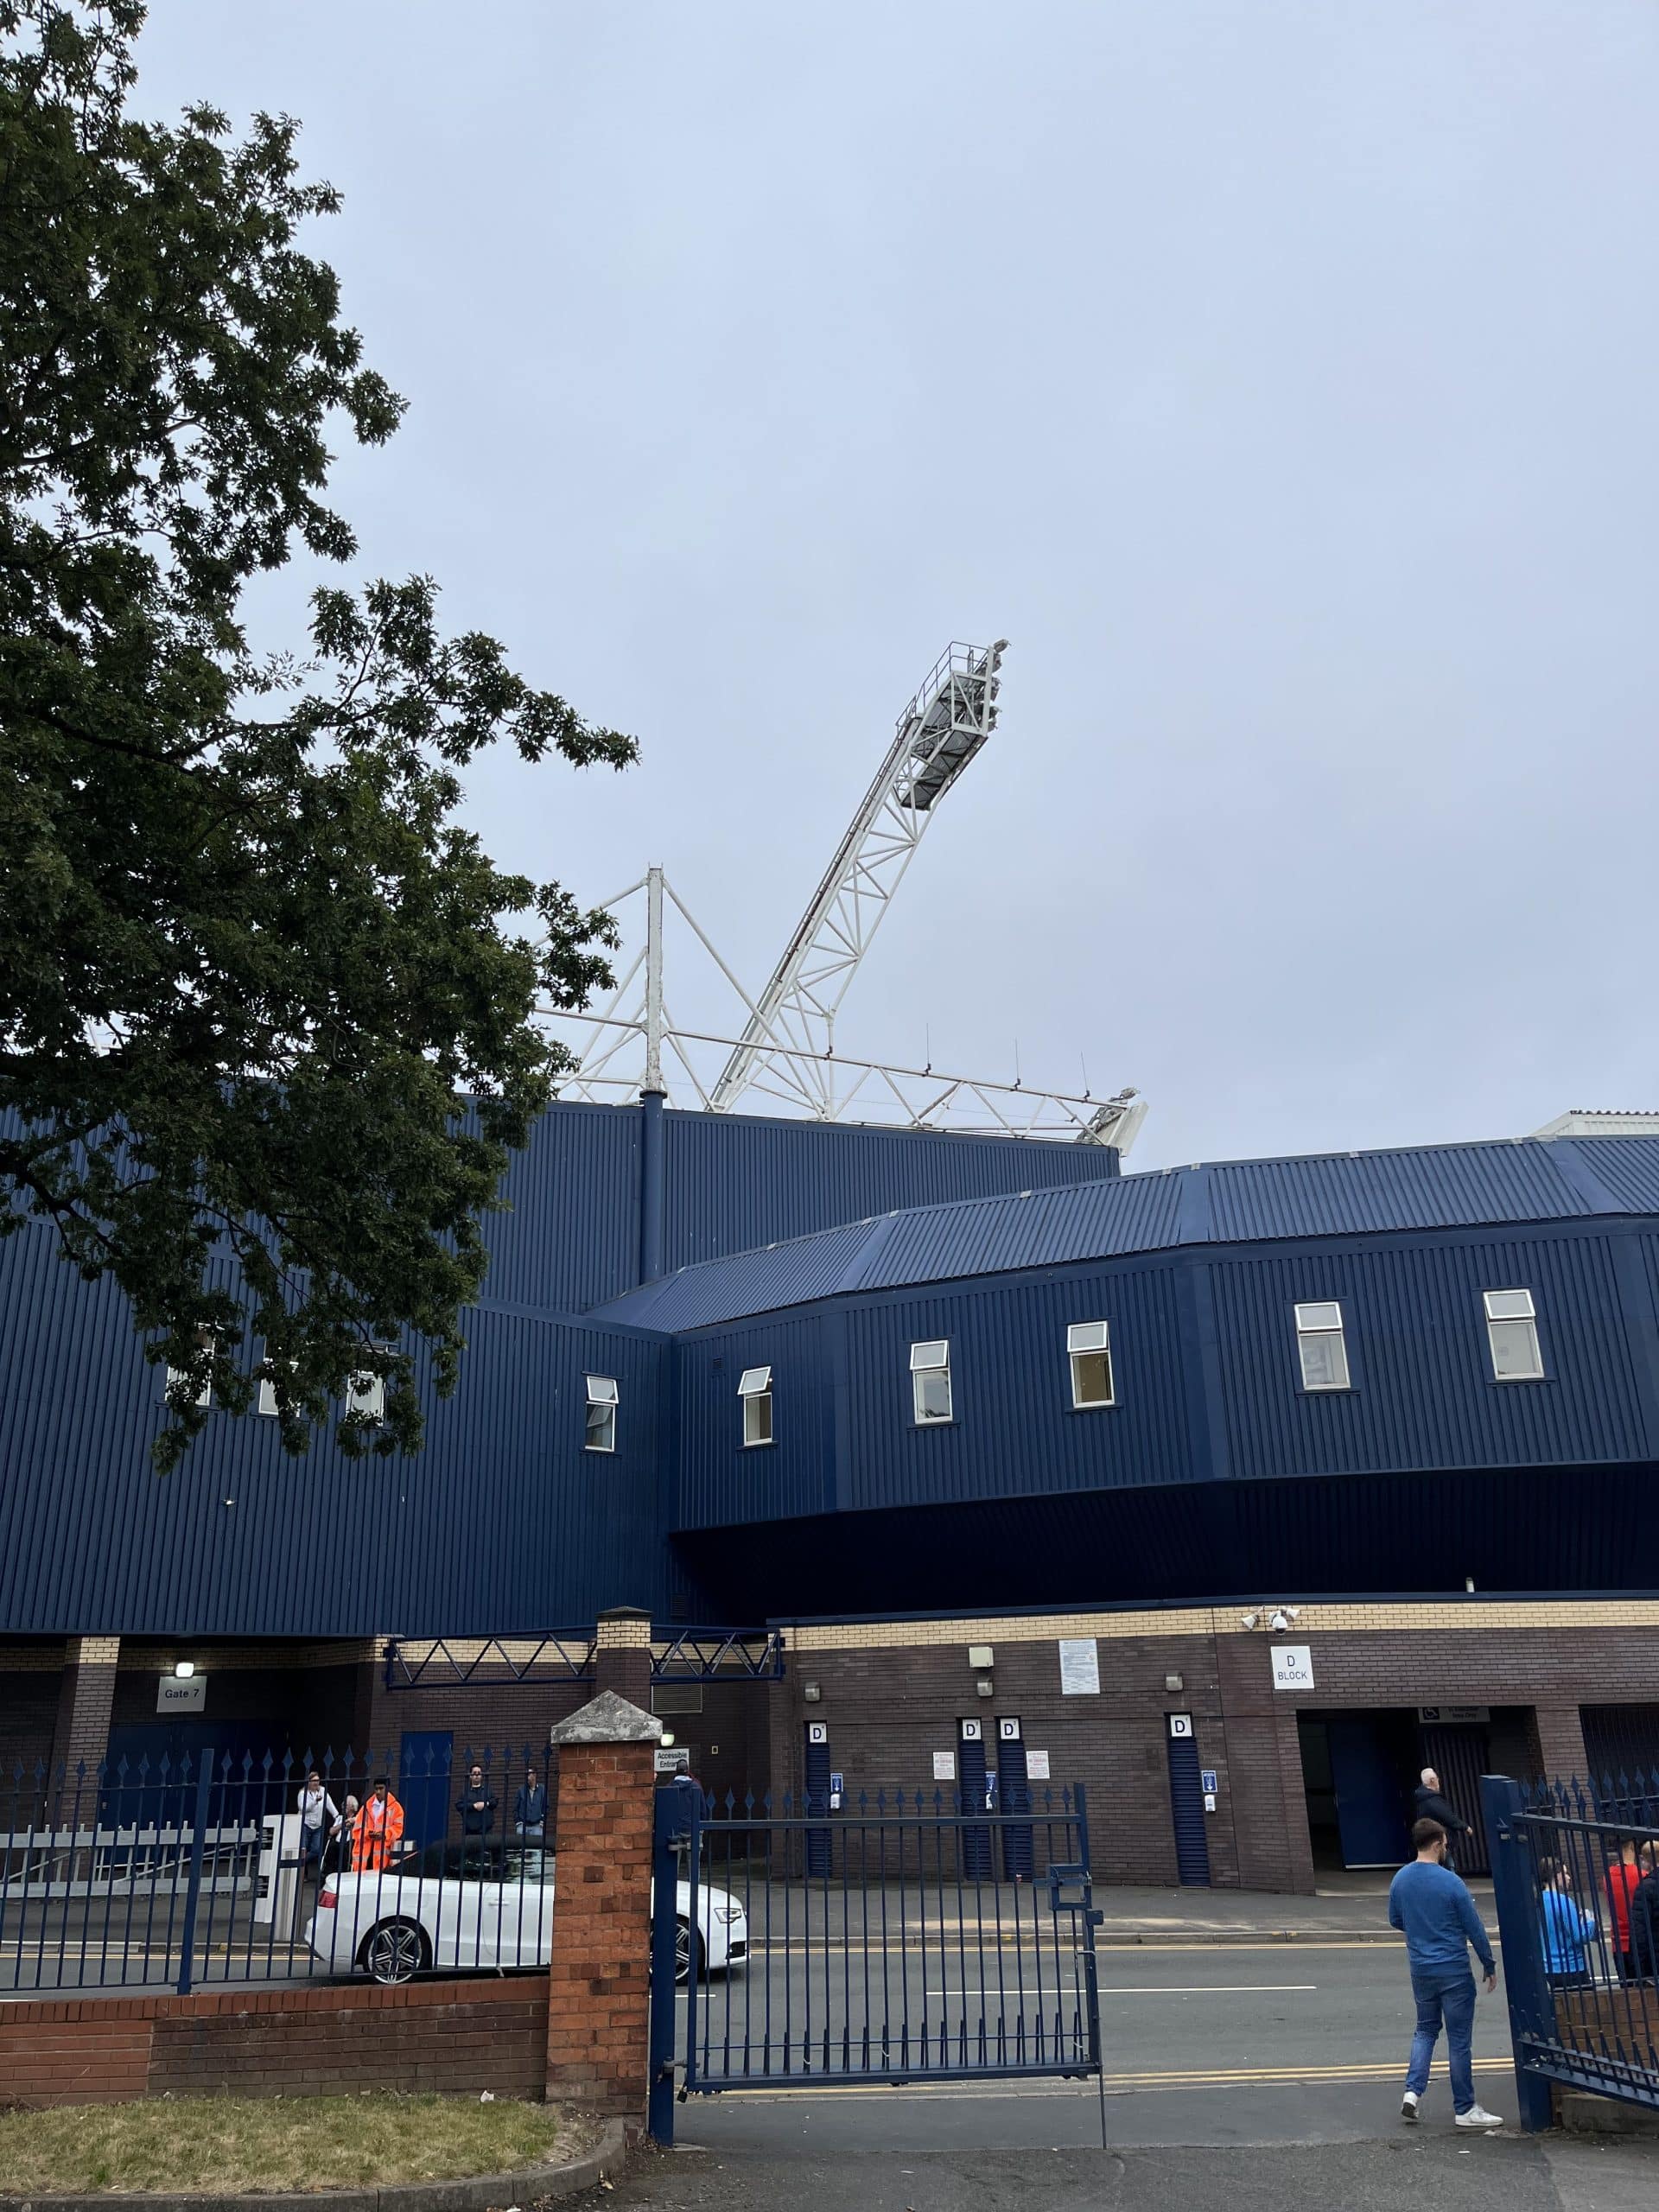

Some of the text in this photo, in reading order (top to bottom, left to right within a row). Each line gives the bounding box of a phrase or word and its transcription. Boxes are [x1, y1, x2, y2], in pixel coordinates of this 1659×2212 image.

[1287, 1656, 1294, 1666] D
[1278, 1671, 1307, 1680] BLOCK
[165, 1688, 200, 1699] Gate 7
